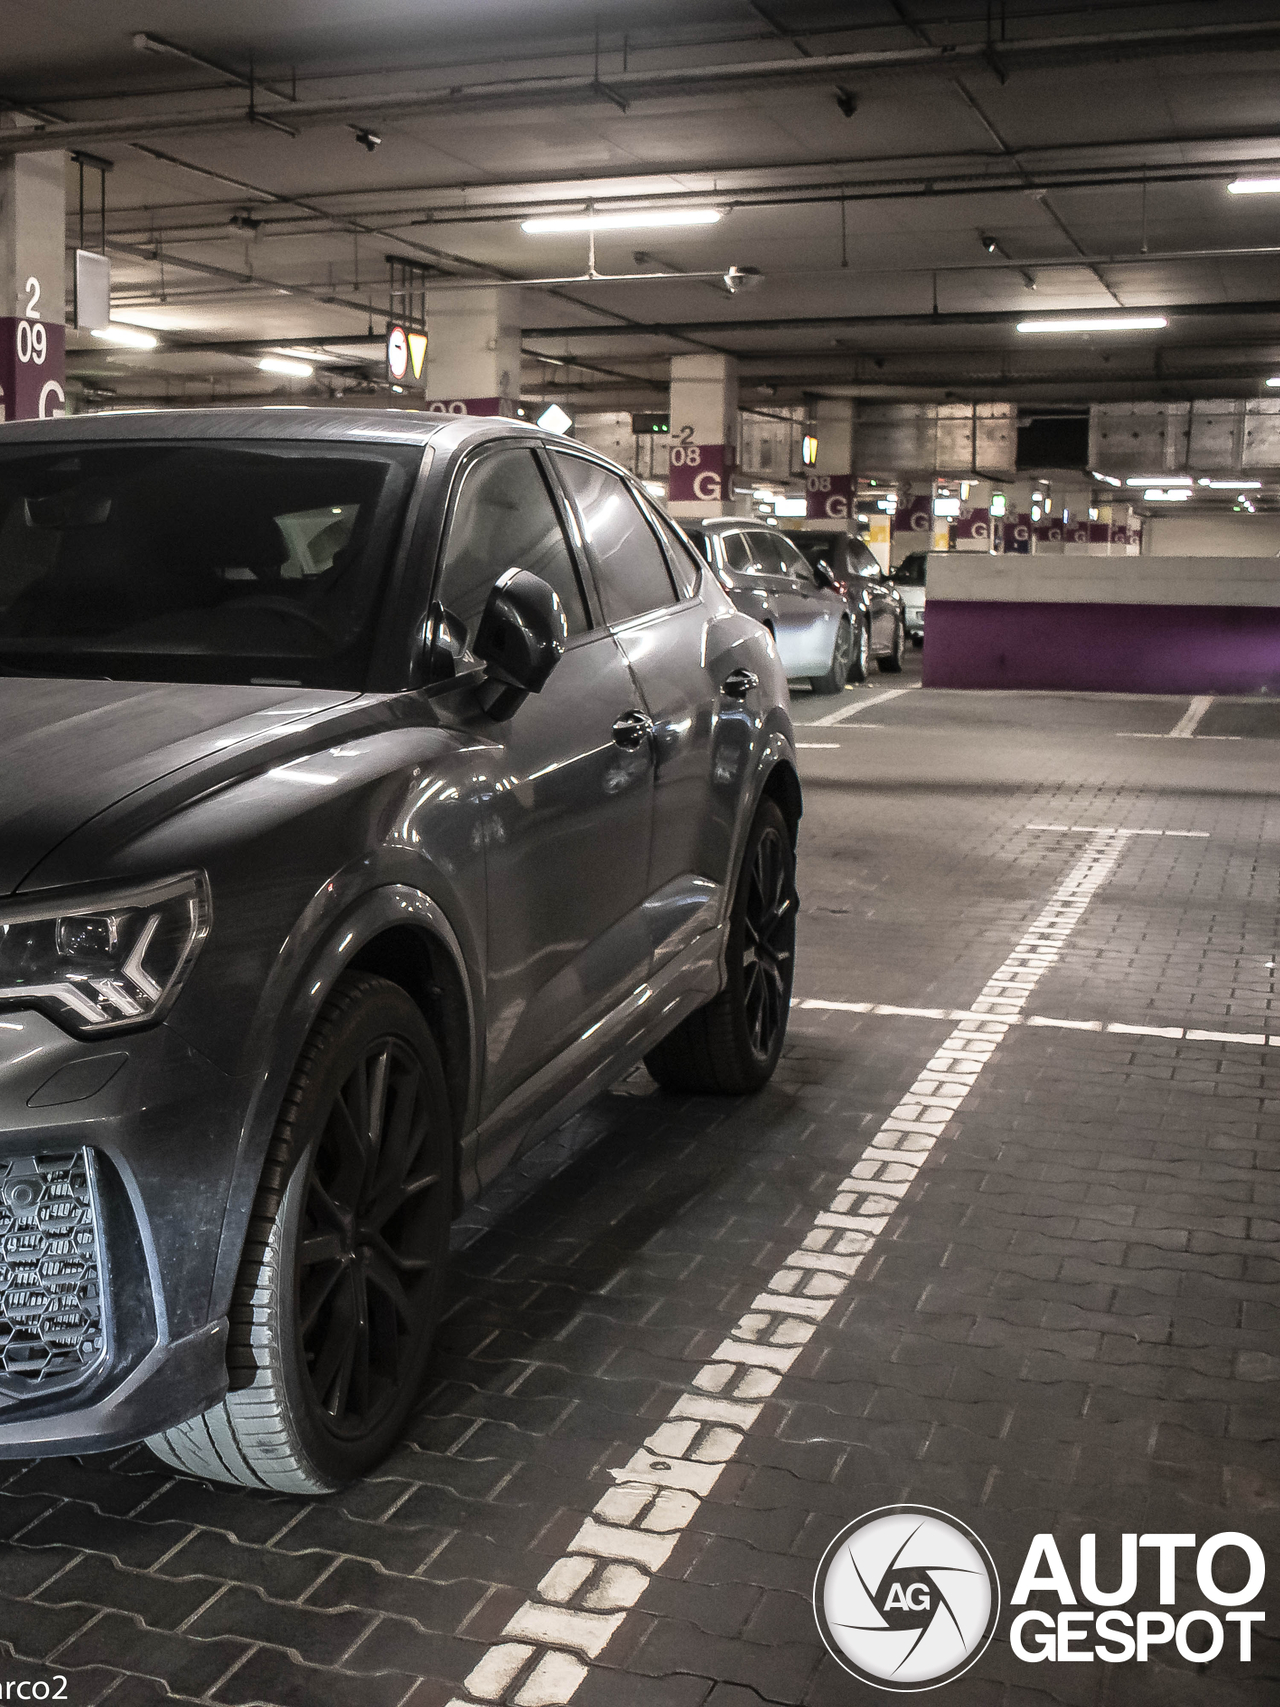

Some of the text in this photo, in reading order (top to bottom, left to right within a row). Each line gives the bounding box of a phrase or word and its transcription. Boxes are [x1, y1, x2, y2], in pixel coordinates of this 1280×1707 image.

[17, 320, 47, 365] 09
[671, 425, 696, 446] -2
[671, 447, 701, 467] 08
[693, 471, 722, 501] G
[807, 476, 831, 491] 08
[826, 496, 847, 518] G
[910, 512, 930, 532] G
[971, 522, 989, 540] G
